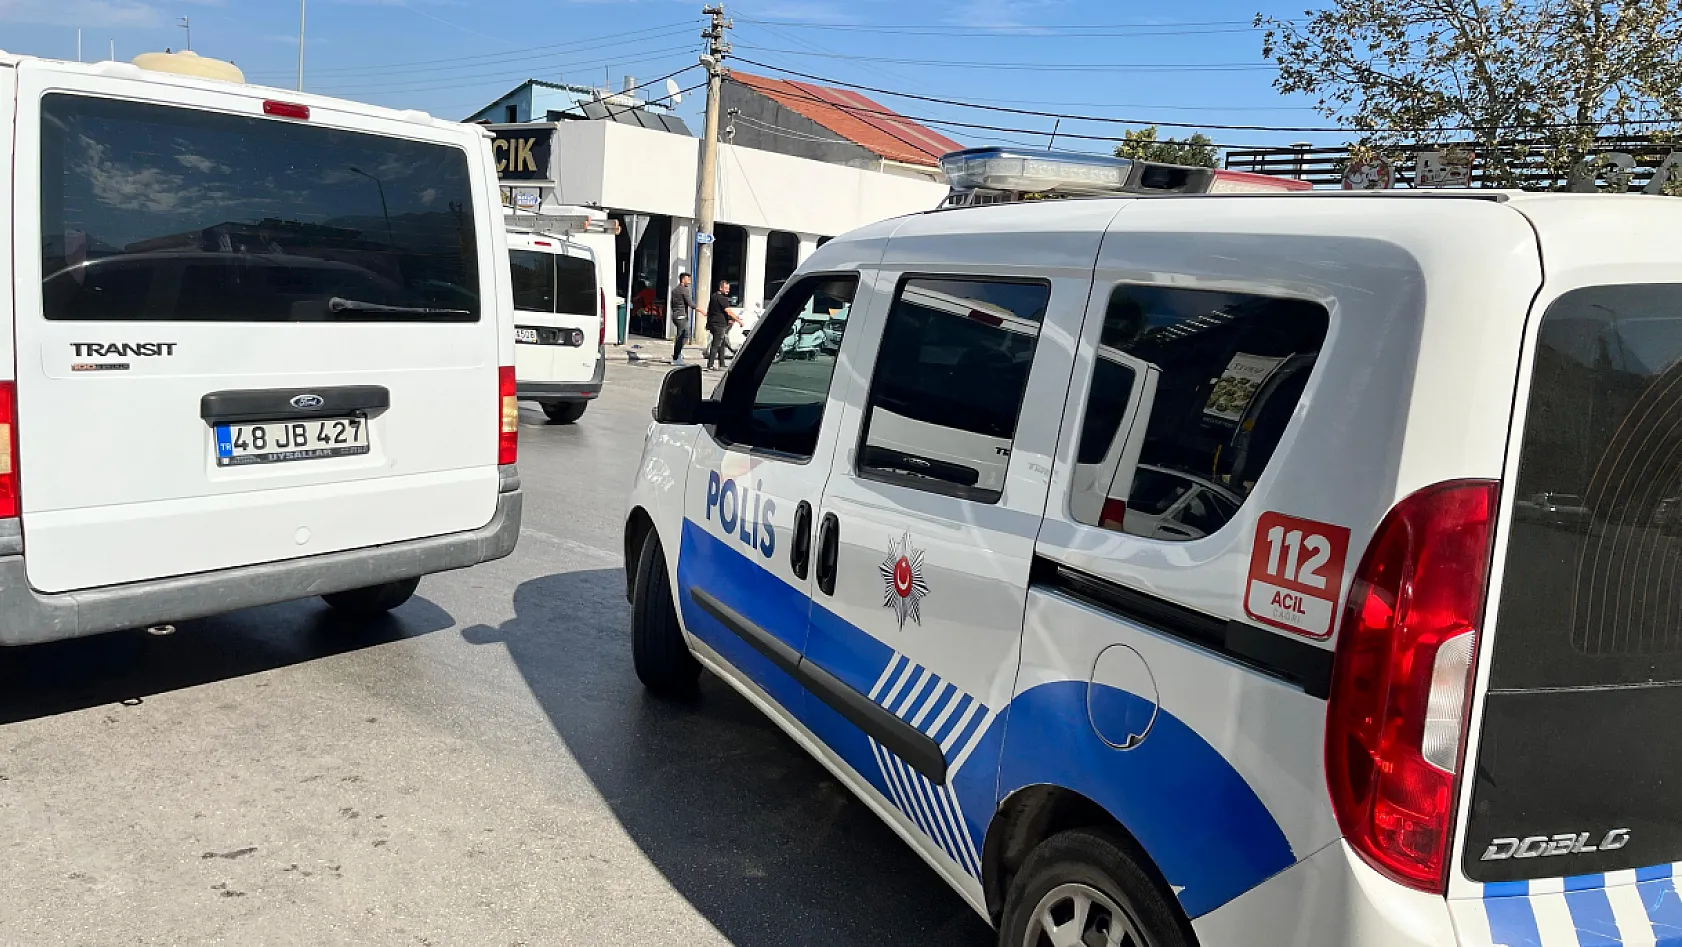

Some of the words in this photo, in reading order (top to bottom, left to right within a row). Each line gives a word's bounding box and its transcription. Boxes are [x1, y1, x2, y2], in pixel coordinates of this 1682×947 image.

[69, 342, 177, 357] TRANSIT
[220, 442, 232, 451] TR
[233, 426, 268, 451] 48
[275, 423, 308, 448] JB
[317, 419, 362, 444] 427
[268, 449, 333, 460] UYSALLAR
[705, 469, 777, 559] POLİS
[1267, 525, 1331, 590] 112
